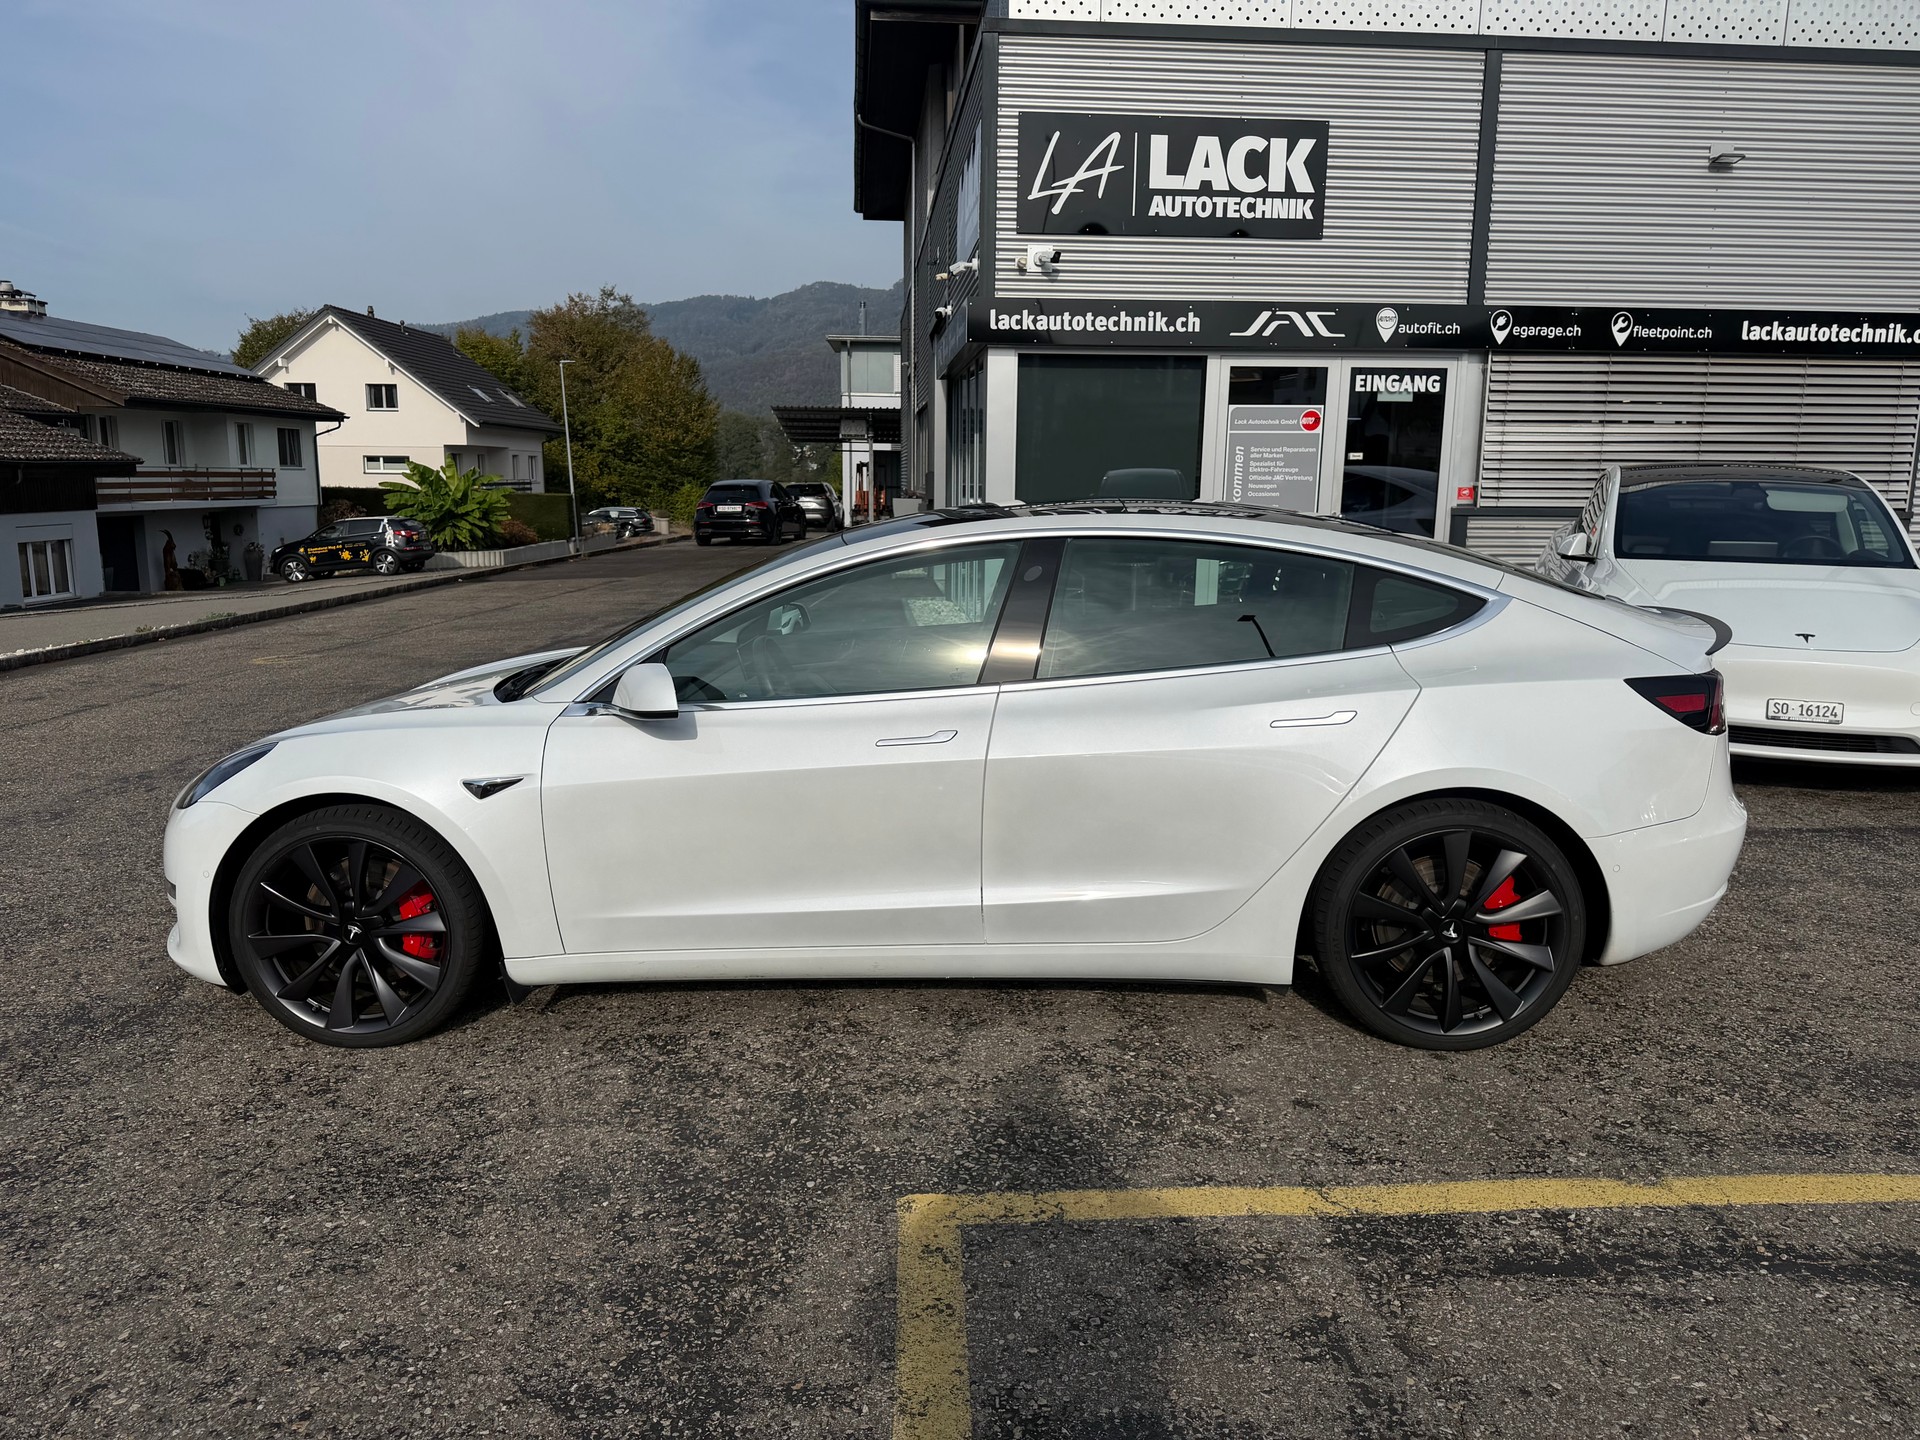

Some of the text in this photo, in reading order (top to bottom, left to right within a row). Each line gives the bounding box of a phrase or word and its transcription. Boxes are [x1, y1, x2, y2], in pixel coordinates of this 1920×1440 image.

[1148, 134, 1317, 194] LACK
[1147, 194, 1315, 220] AUTOTECHNIK
[989, 308, 1201, 334] lackautotechnik.ch
[1398, 321, 1461, 335] autofit.ch
[1512, 325, 1582, 338] egarage.ch
[1633, 325, 1712, 340] fleetpoint.ch
[1354, 374, 1441, 393] EINGANG
[1282, 446, 1317, 454] Reparaturen
[1772, 702, 1838, 719] SO 16124
